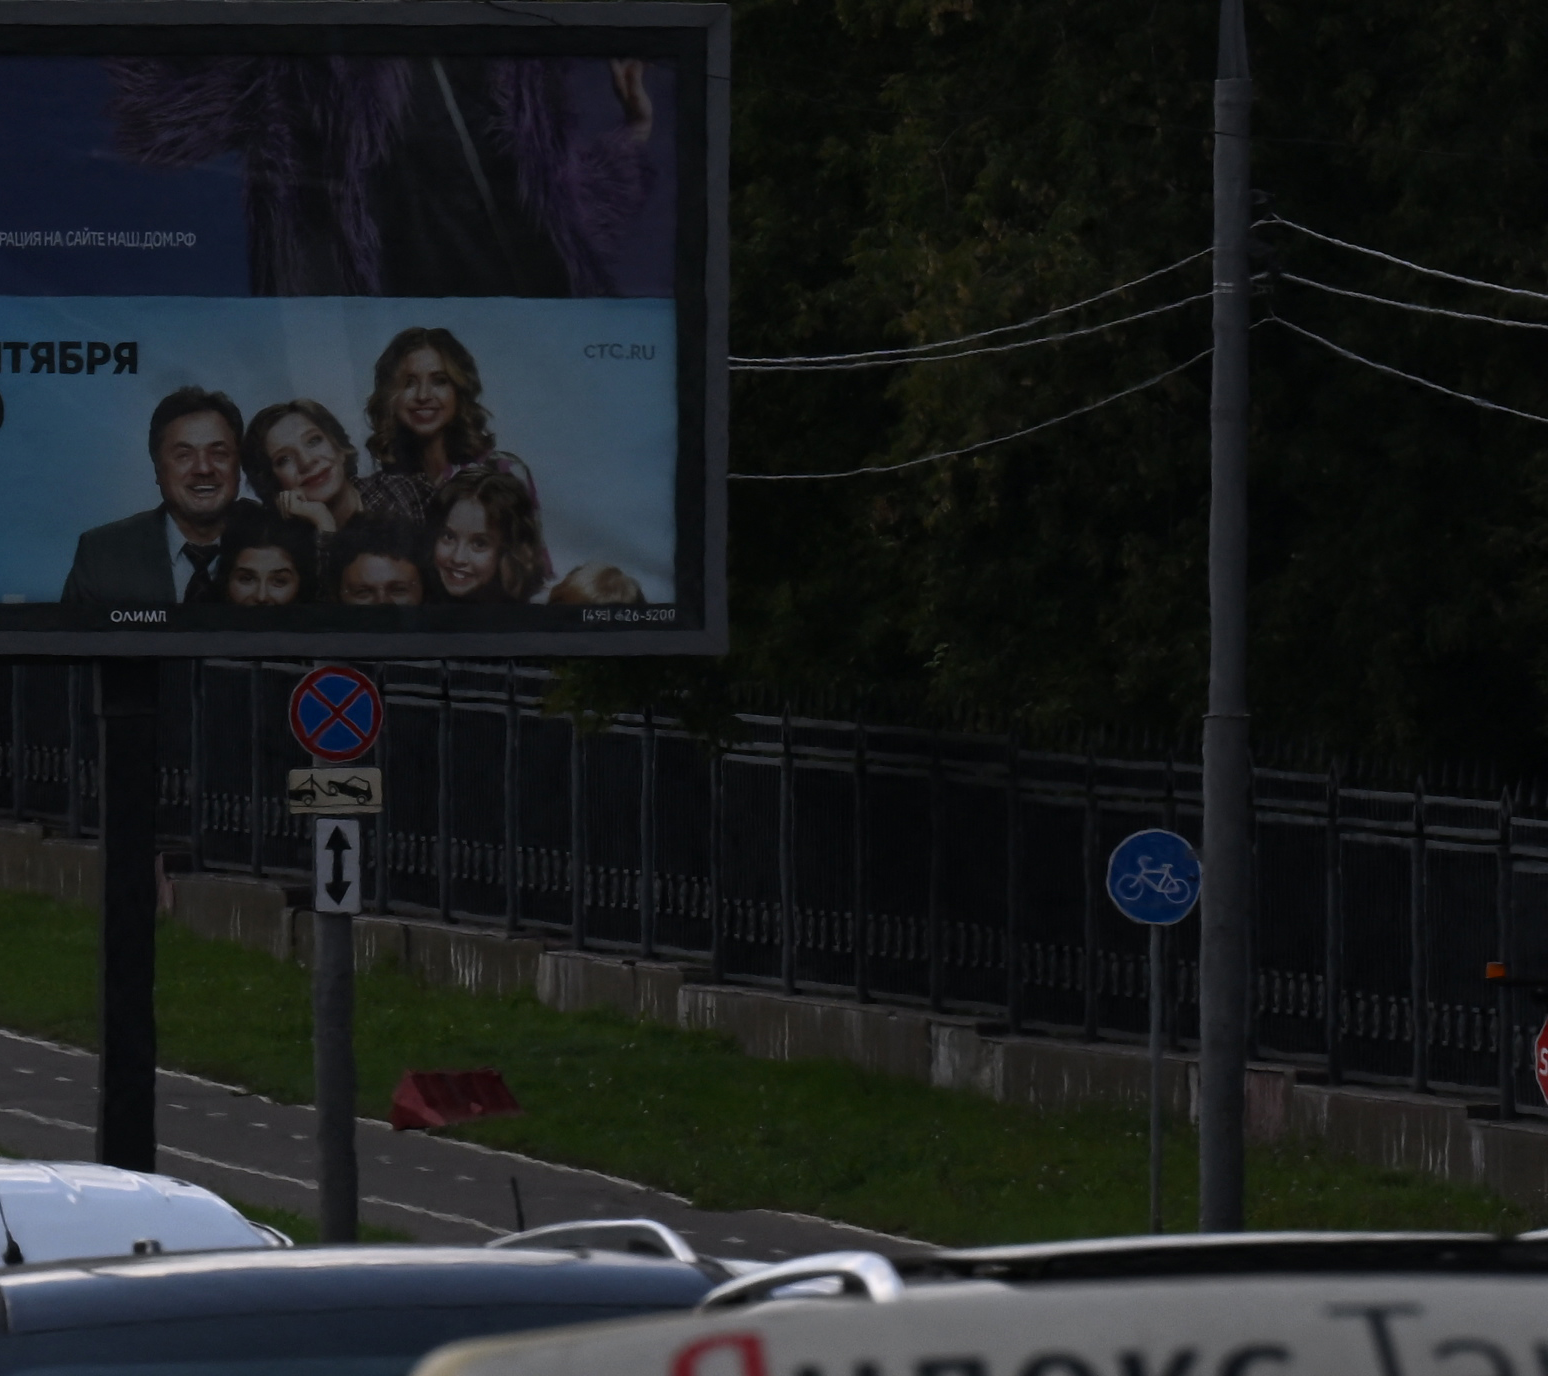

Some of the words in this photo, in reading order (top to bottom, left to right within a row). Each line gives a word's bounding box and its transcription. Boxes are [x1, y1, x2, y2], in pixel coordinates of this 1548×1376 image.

[44, 232, 63, 246] НА
[66, 227, 105, 247] САЙТЕ
[110, 610, 167, 623] ОЛИМП
